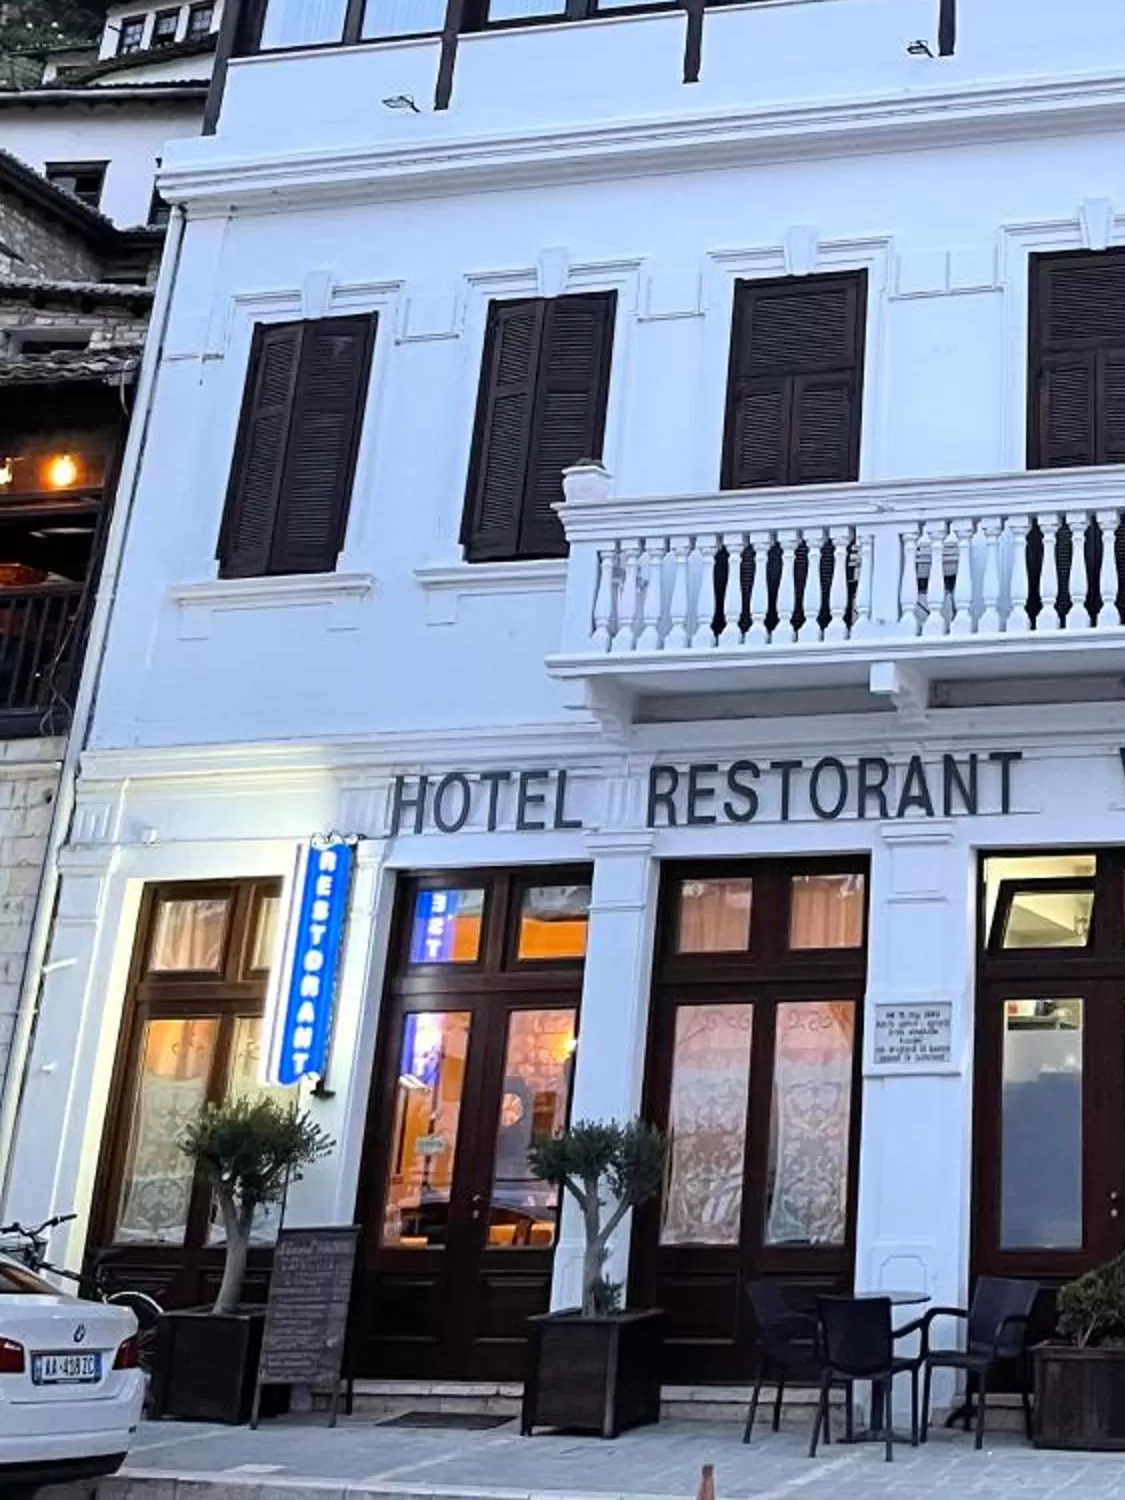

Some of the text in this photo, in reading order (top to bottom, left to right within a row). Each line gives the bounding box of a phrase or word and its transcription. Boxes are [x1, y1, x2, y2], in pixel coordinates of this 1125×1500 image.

[391, 769, 584, 836] HOTEL
[646, 751, 1023, 829] RESTORANT
[292, 851, 338, 1075] RESTORANT
